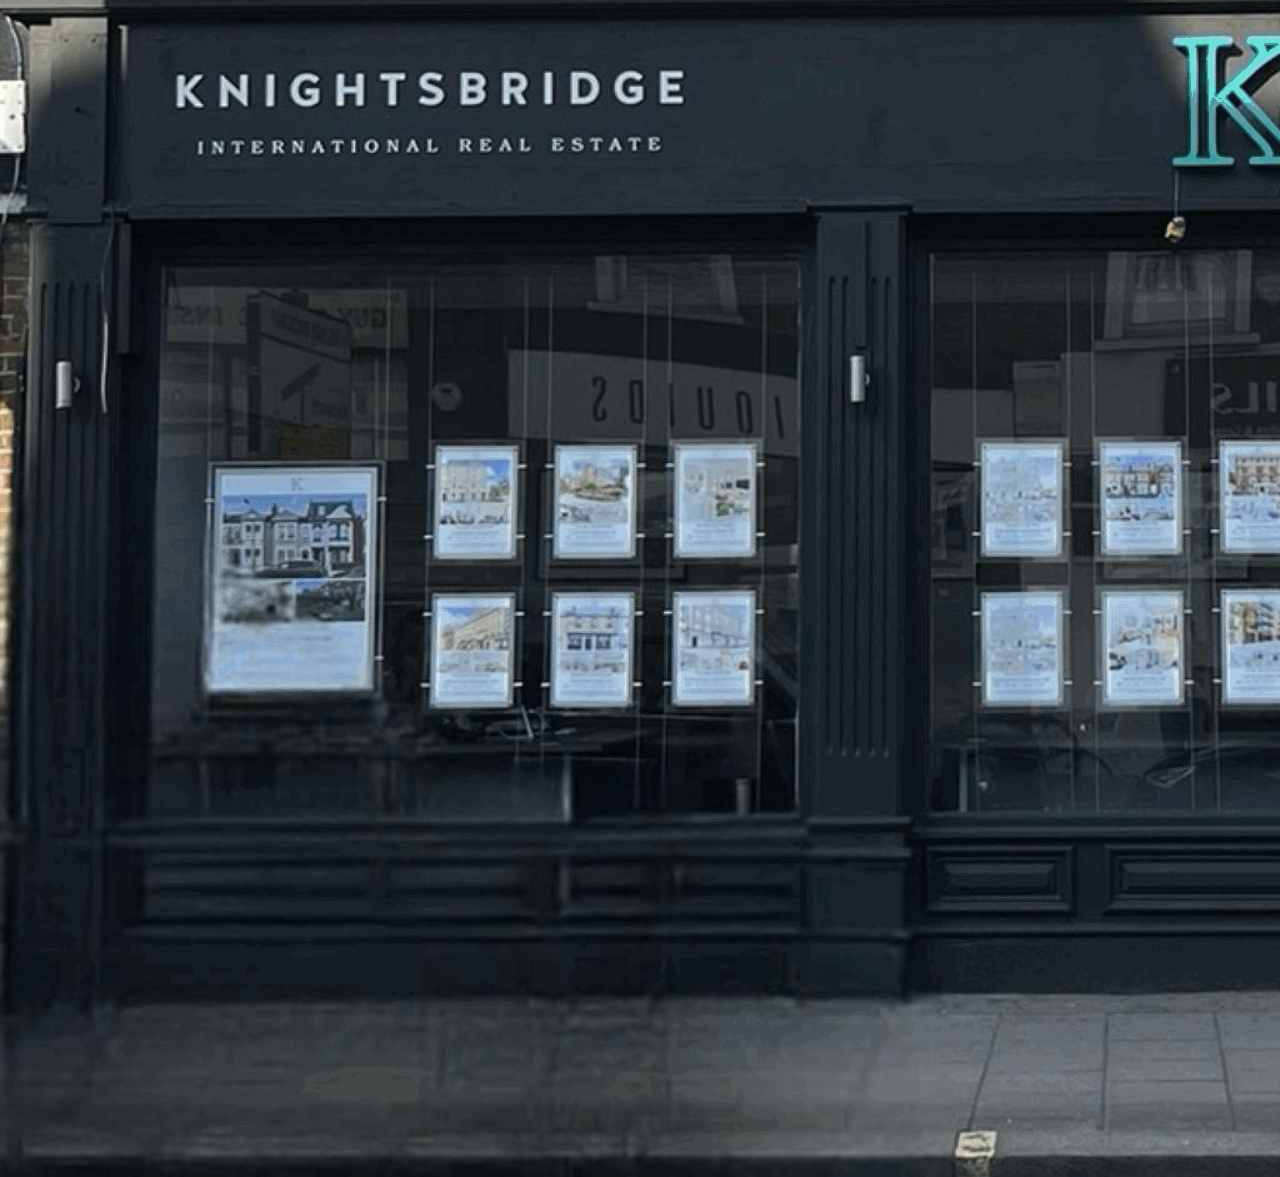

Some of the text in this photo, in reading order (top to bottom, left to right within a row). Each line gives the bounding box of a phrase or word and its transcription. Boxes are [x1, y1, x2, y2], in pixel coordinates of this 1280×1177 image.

[175, 69, 685, 109] KNIGHTSBRIDGE
[196, 136, 662, 155] INTERNATIONAL REAL ESTATE
